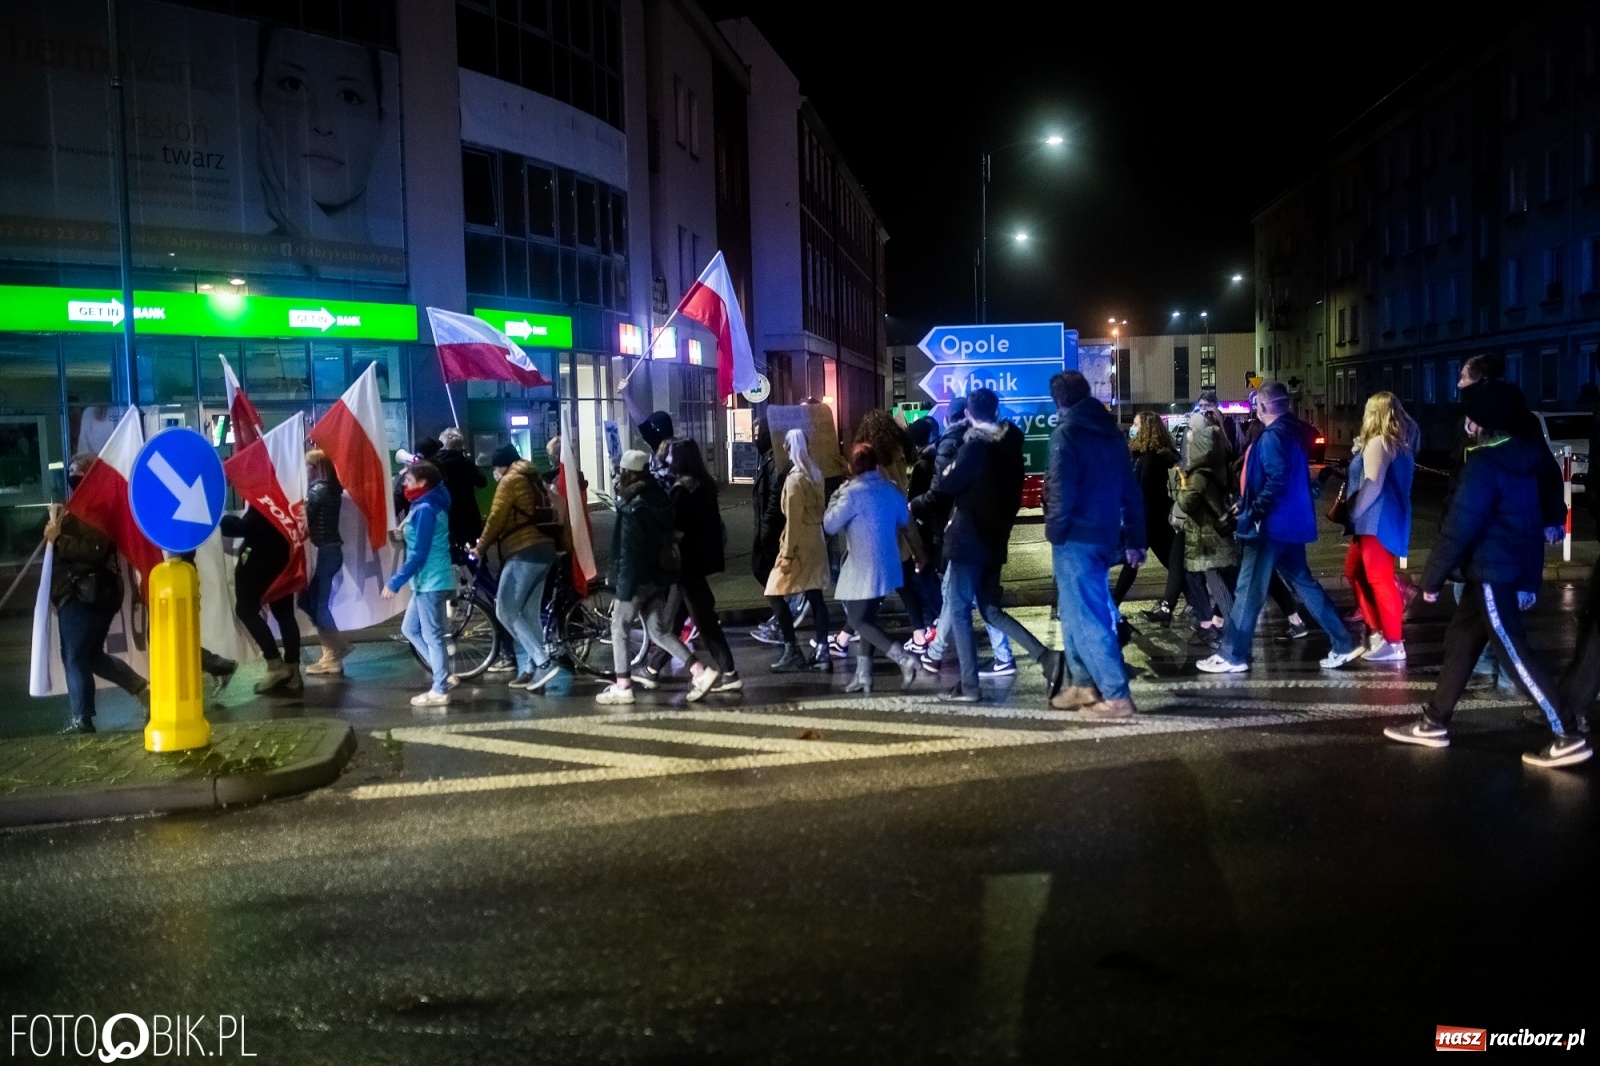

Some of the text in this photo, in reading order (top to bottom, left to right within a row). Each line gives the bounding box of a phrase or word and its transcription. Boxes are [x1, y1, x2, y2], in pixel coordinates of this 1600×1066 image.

[161, 144, 225, 171] twarz
[133, 306, 166, 320] BANK
[940, 333, 1010, 360] Opole
[942, 371, 1018, 397] Rybnik
